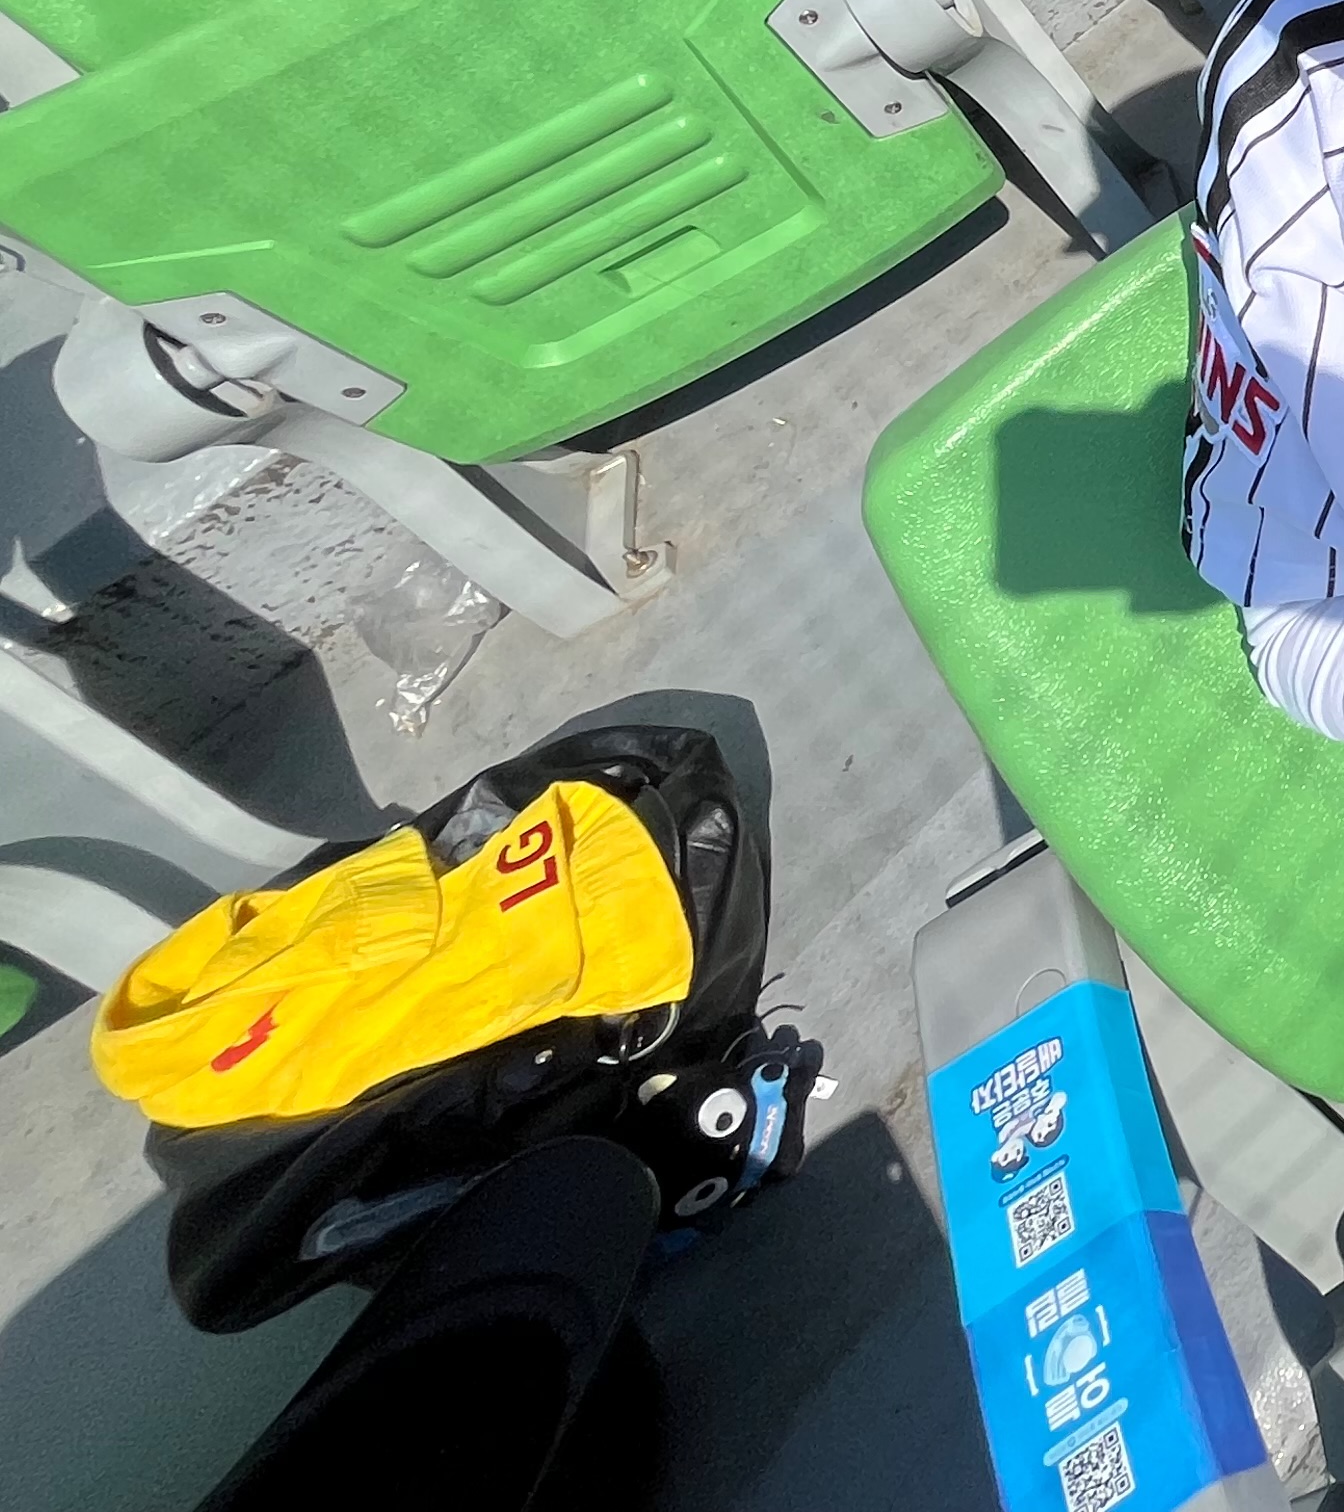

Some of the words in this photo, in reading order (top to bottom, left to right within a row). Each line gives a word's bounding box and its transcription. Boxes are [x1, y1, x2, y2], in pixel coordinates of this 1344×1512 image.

[496, 820, 560, 913] LG
[970, 1036, 1064, 1116] 배달타자
[991, 1076, 1052, 1128] 주문은
[1024, 1268, 1091, 1339] 클립
[1044, 1361, 1111, 1432] 오늘
